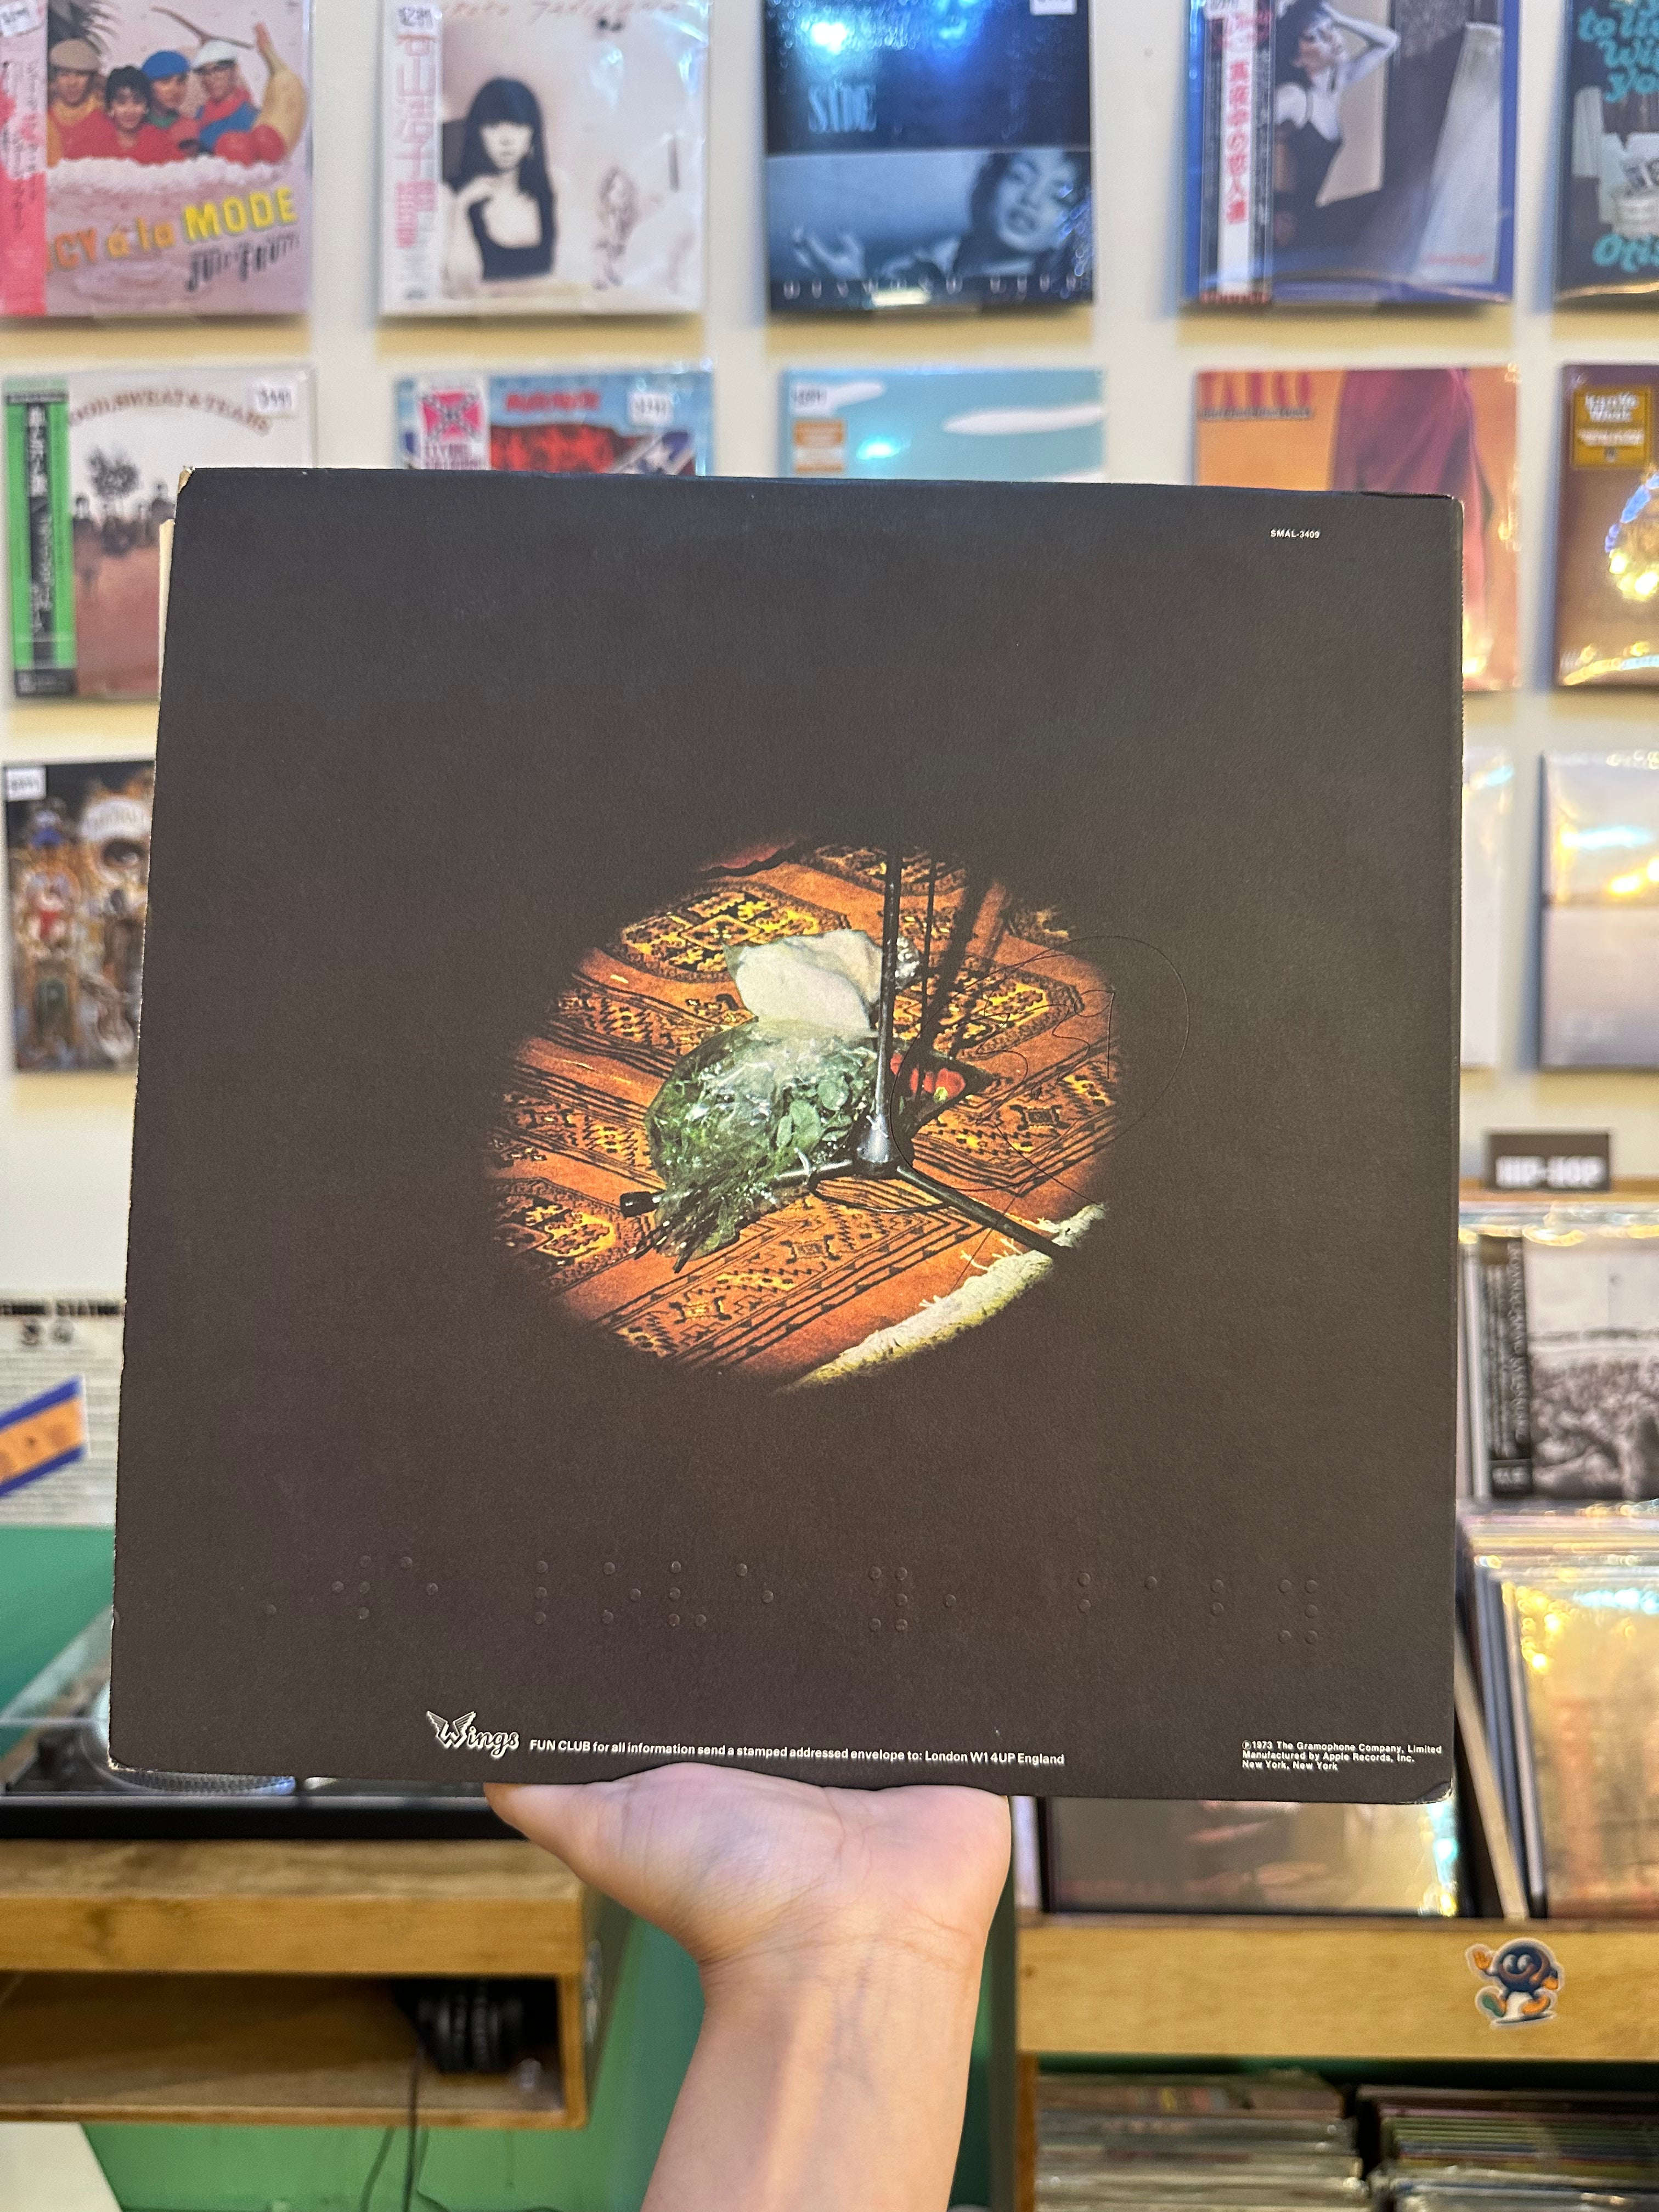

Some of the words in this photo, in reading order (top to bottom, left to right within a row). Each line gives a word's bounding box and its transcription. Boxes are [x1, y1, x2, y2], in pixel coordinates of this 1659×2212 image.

[183, 187, 298, 241] MODE
[1270, 529, 1321, 539] SMAL-3409
[1495, 1155, 1605, 1188] HIP-HOP
[426, 1711, 520, 1759] Wings
[529, 1739, 556, 1751] FUN
[557, 1740, 591, 1752] CLUB
[592, 1741, 610, 1752] for
[611, 1742, 625, 1753] all
[627, 1742, 695, 1754] information
[697, 1745, 726, 1756] send
[727, 1747, 735, 1756] a
[737, 1746, 787, 1759] stamped
[789, 1747, 849, 1759] addressed
[850, 1749, 905, 1762] envelope
[907, 1751, 922, 1761] to:
[925, 1750, 968, 1762] London
[970, 1752, 988, 1763] W1
[990, 1752, 1015, 1763] 4UP
[1017, 1753, 1065, 1766] England
[1276, 1741, 1294, 1750] The
[1296, 1741, 1356, 1752] Gramophone
[1358, 1743, 1405, 1754] Company,
[1407, 1745, 1442, 1754] Limited
[1242, 1750, 1306, 1759] Manufactured
[1308, 1752, 1320, 1761] by
[1322, 1752, 1350, 1762] Apple
[1352, 1752, 1394, 1763] Records,
[1397, 1753, 1415, 1763] Inc.
[1242, 1759, 1262, 1769] New
[1265, 1760, 1290, 1770] York,
[1293, 1760, 1313, 1770] New
[1316, 1761, 1338, 1770] York
